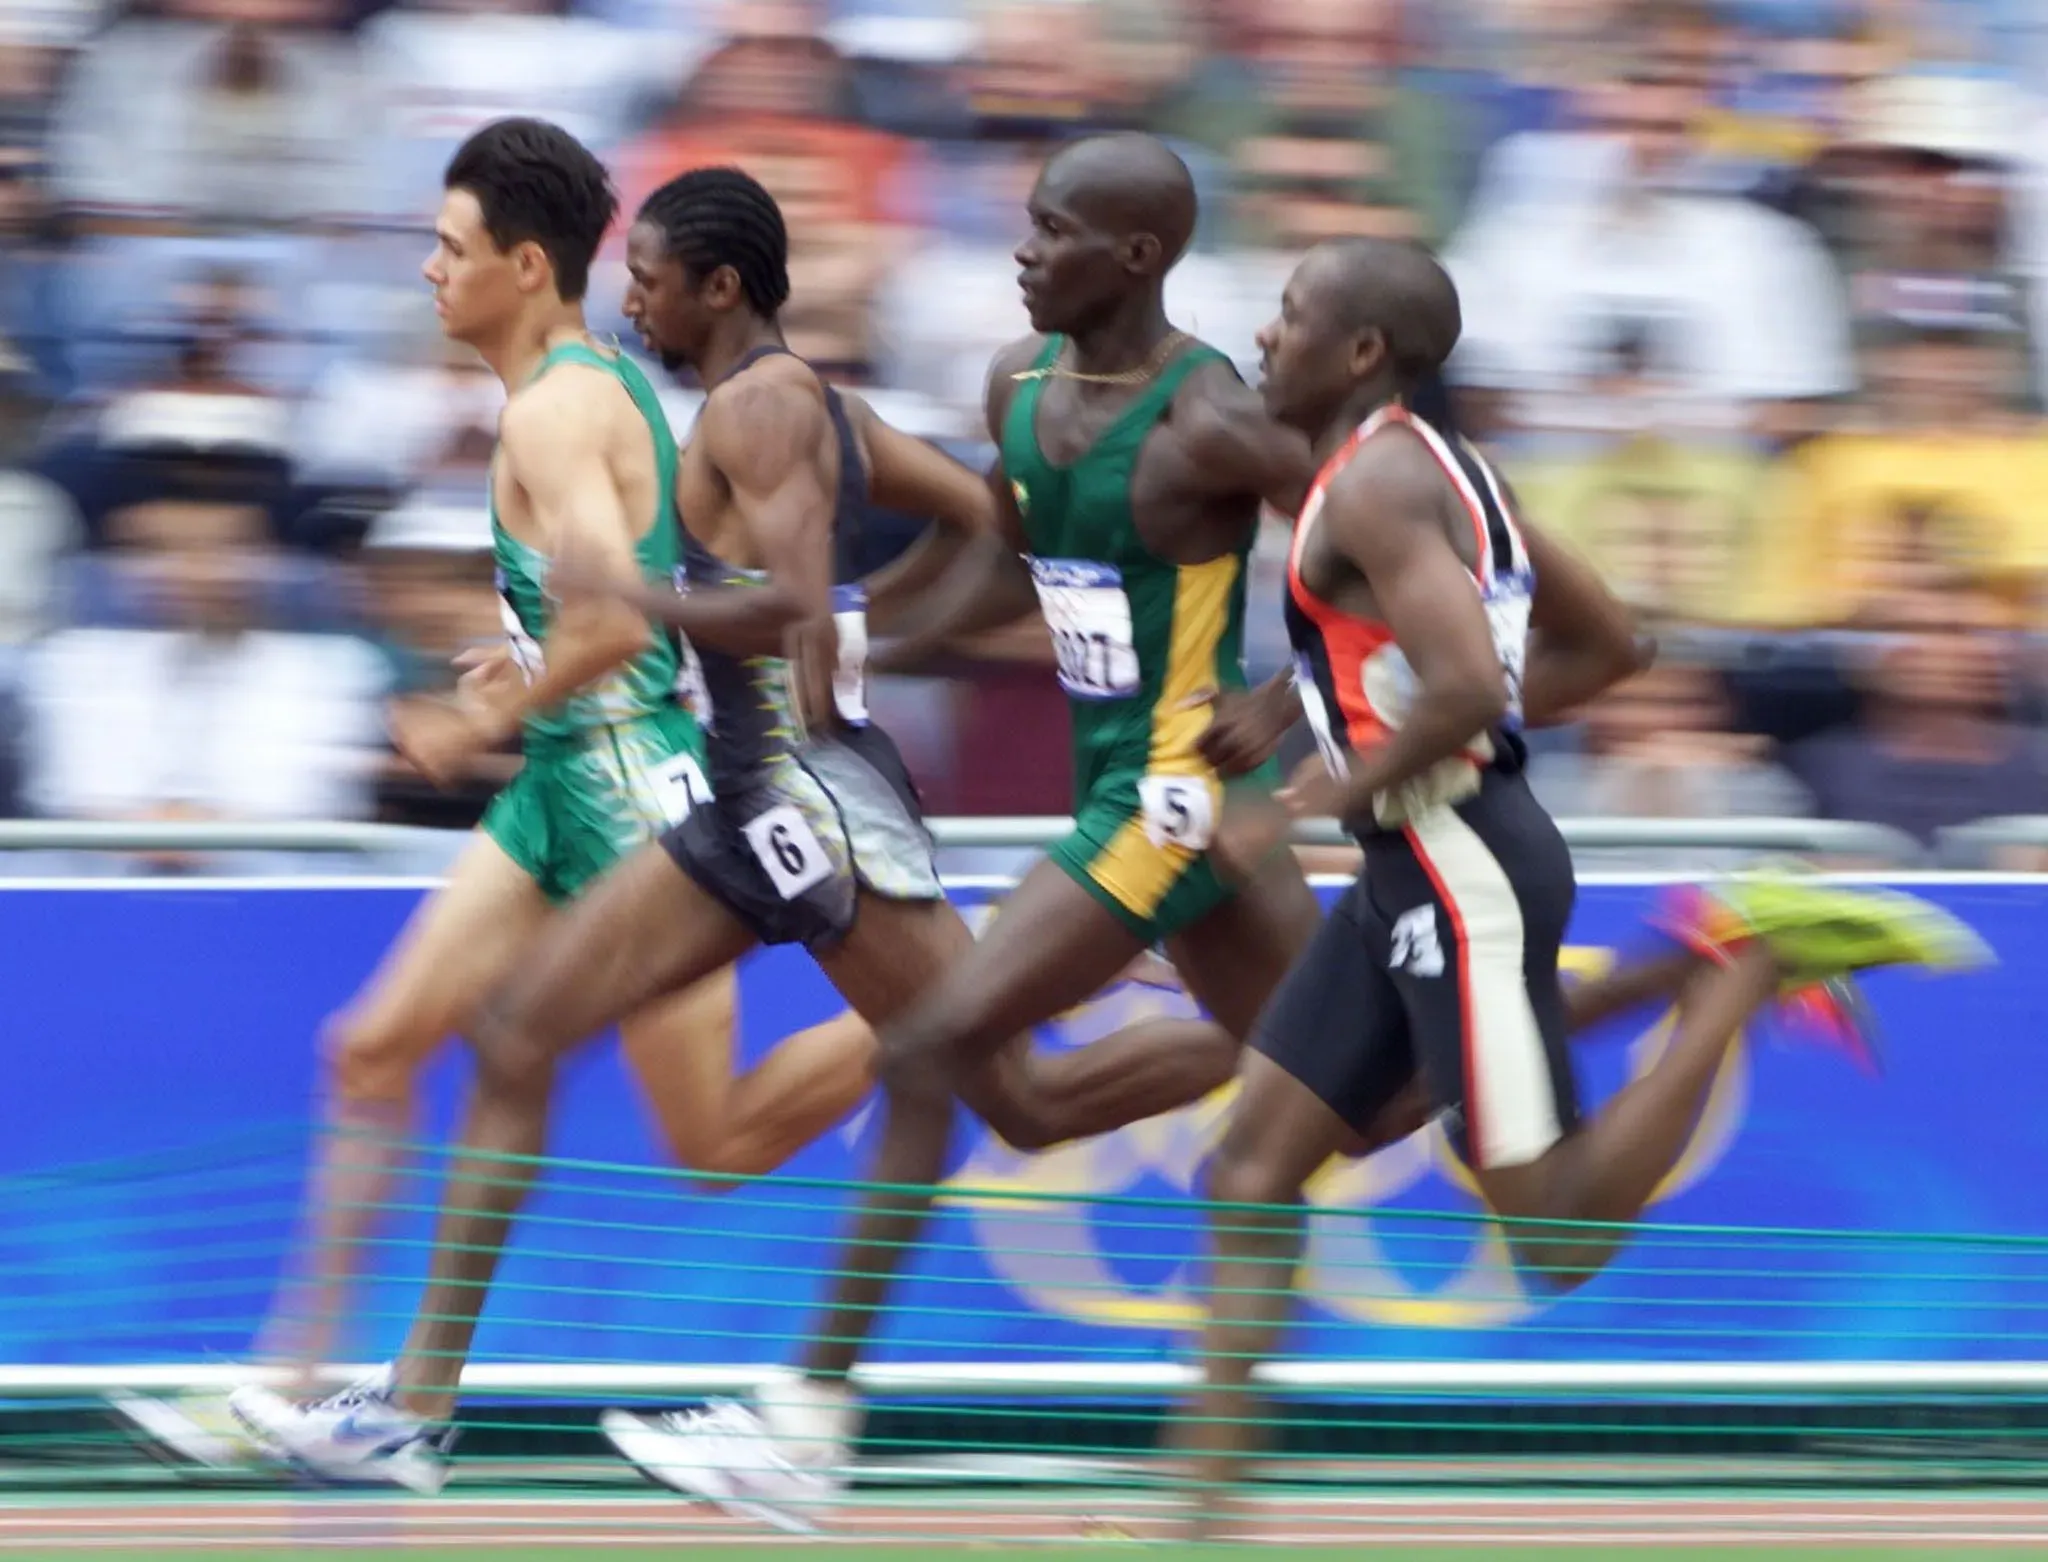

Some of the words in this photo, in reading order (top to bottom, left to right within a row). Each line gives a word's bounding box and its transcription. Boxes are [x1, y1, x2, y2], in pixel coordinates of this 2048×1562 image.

[668, 771, 697, 806] 7
[1161, 785, 1190, 838] 5
[770, 822, 805, 877] 6
